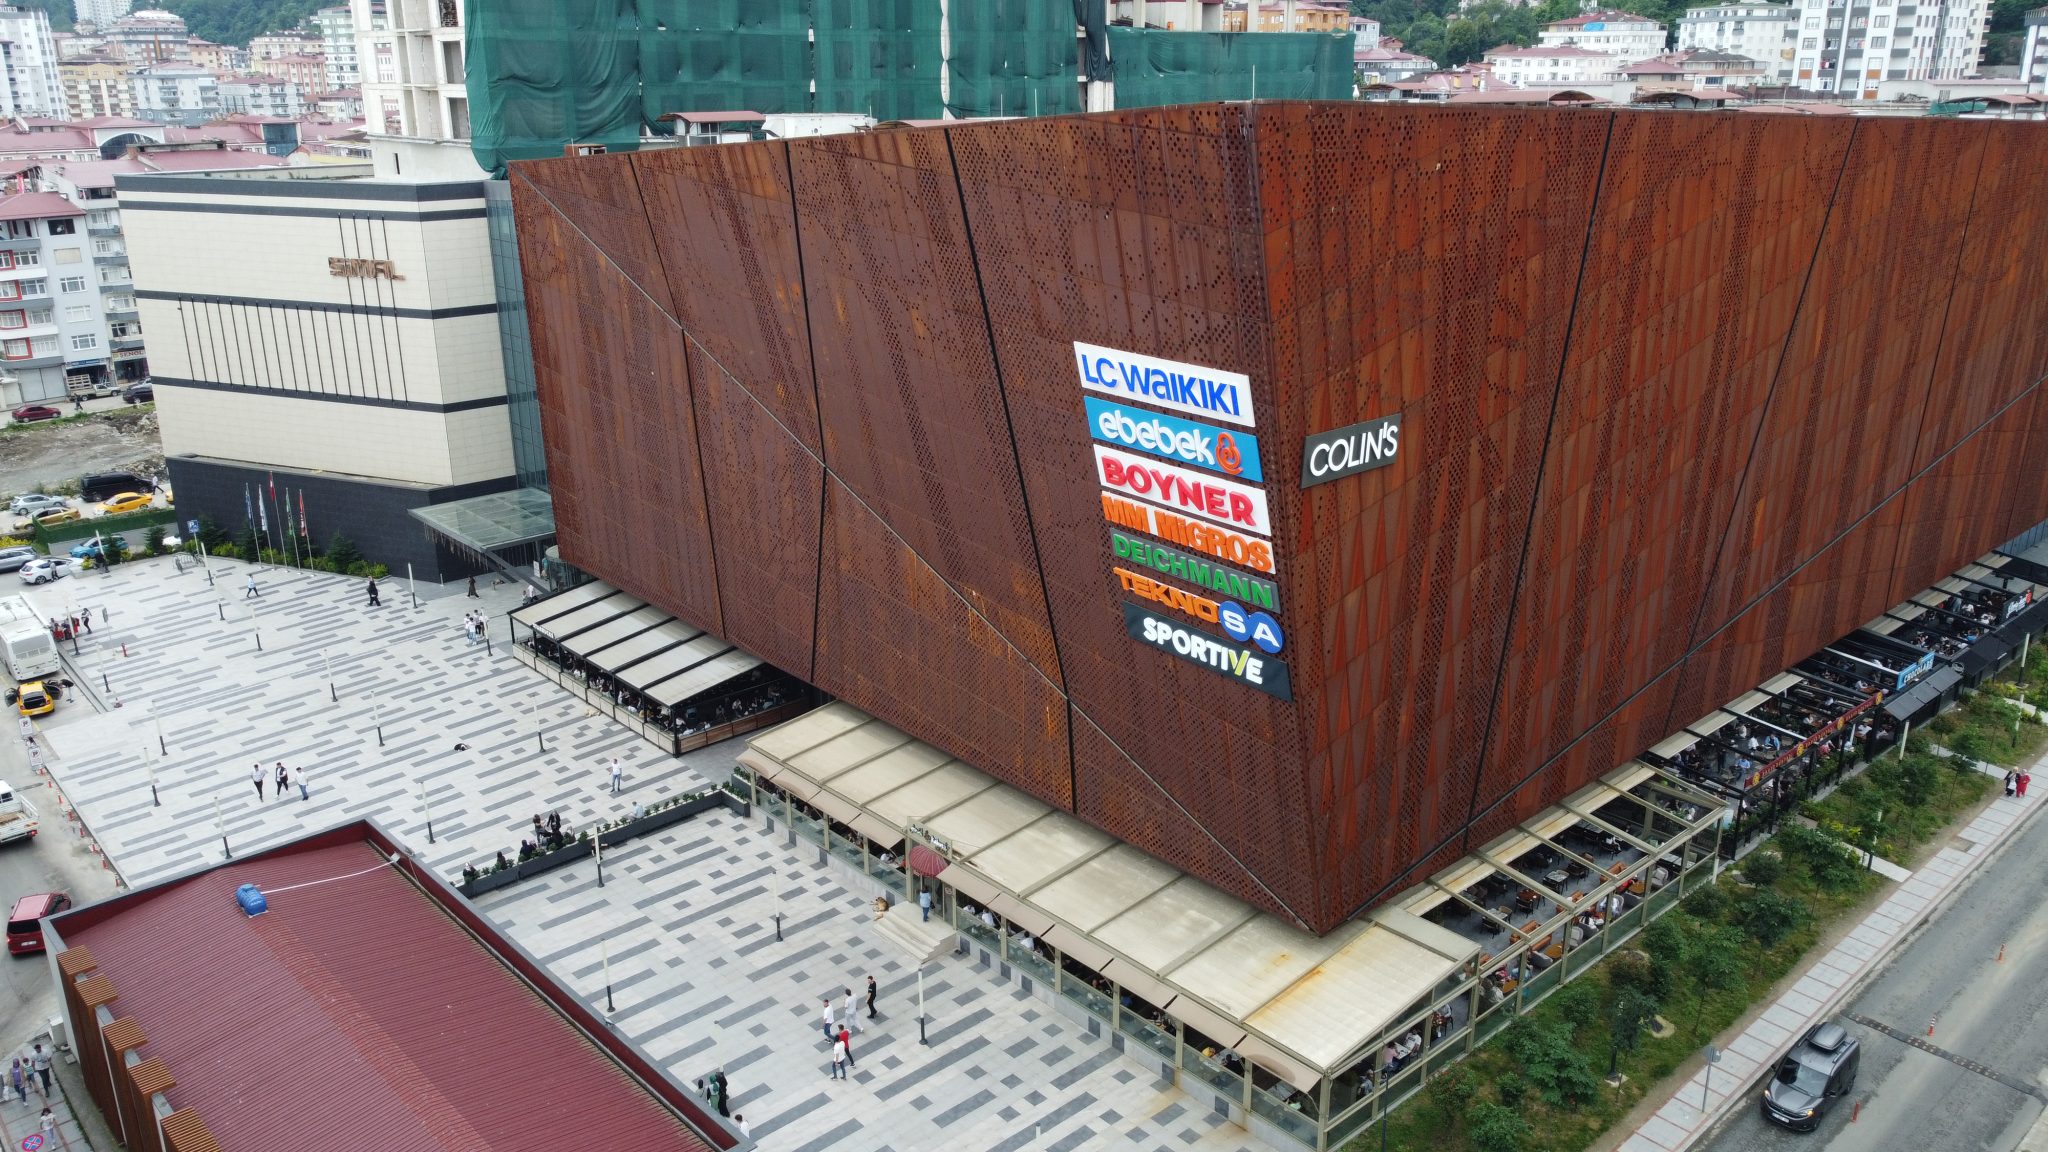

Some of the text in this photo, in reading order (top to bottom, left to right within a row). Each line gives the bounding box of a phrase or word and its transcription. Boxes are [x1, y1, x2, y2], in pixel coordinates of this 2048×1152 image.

[1082, 354, 1117, 388] LC
[1099, 410, 1215, 466] ebebek
[1310, 422, 1398, 476] COLIN'S
[1101, 455, 1257, 527] BOYNER
[1102, 495, 1149, 533] MM
[1113, 533, 1272, 609] DEICHMANN
[1143, 618, 1262, 684] SPORTIVE
